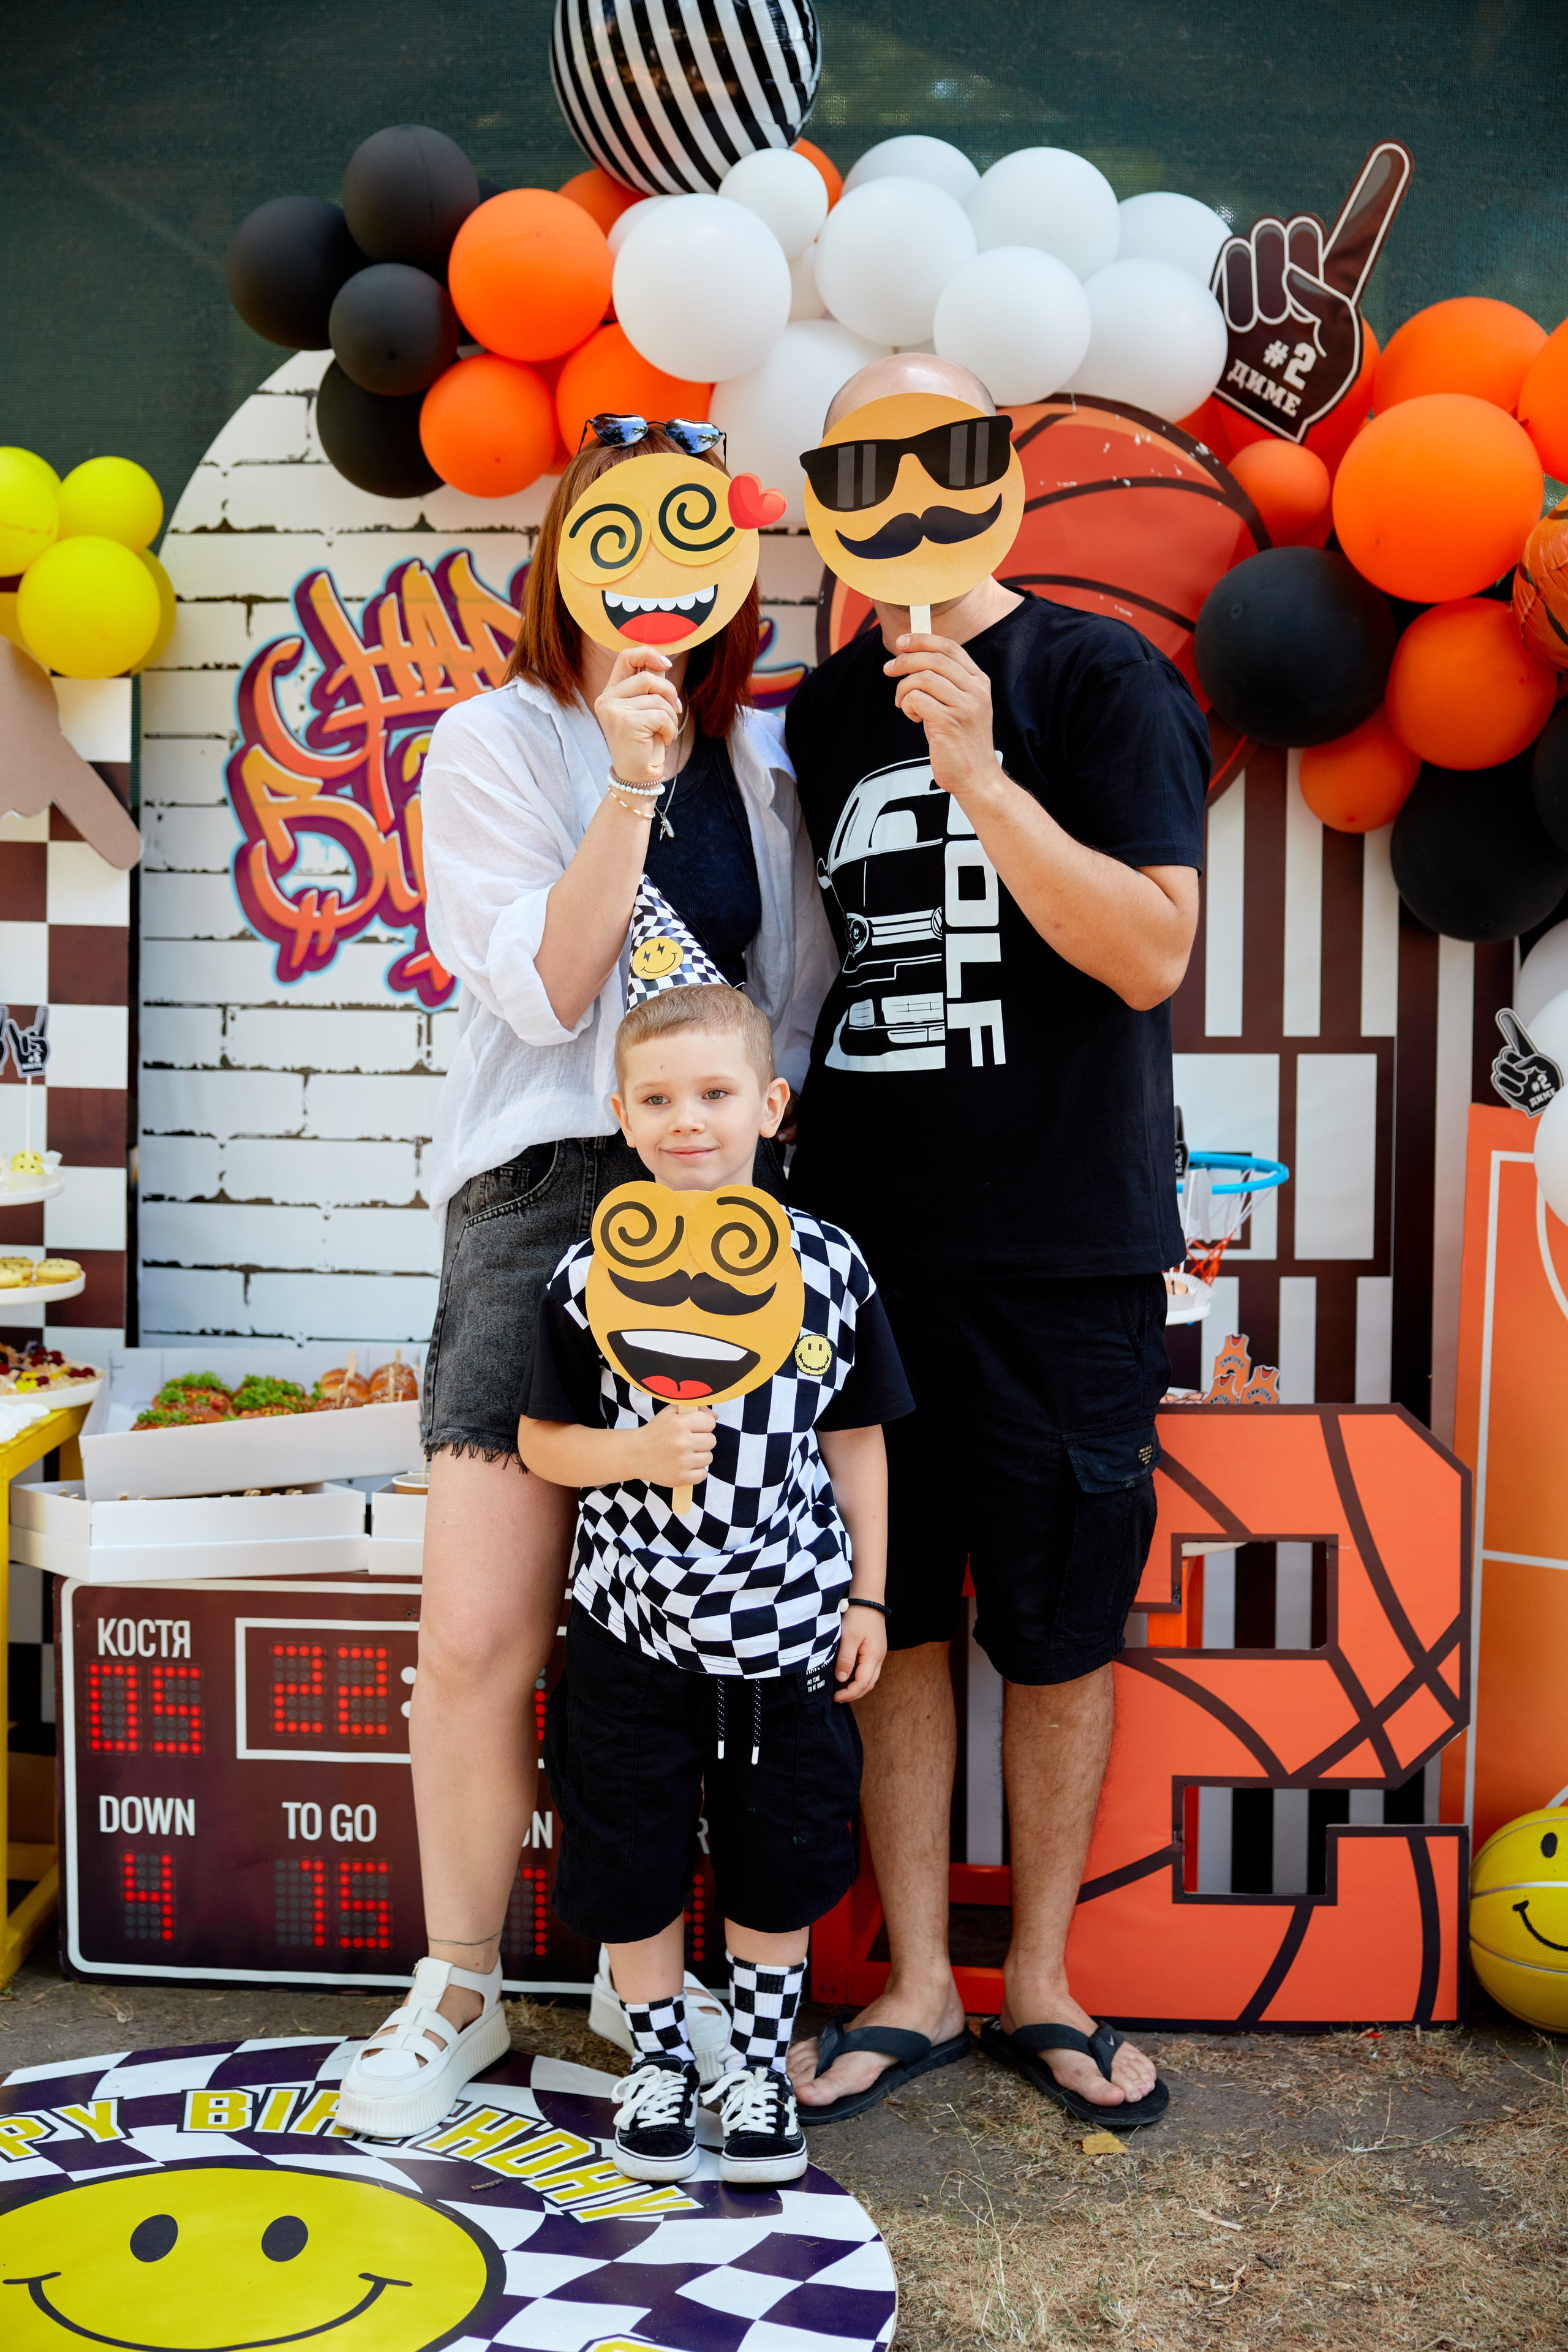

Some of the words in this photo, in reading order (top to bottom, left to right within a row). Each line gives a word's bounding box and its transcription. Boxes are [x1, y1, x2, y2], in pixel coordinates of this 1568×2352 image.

[1227, 358, 1302, 418] ДИМЕ
[1262, 339, 1317, 391] #2
[96, 1617, 191, 1659] КОСТЯ
[88, 1663, 202, 1755] 05
[99, 1795, 196, 1836] DOWN
[281, 1801, 322, 1841] TO
[330, 1804, 377, 1842] GO
[123, 1853, 173, 1941] 4
[299, 1858, 391, 1950] 15
[183, 2088, 704, 2224] BIRHDAY
